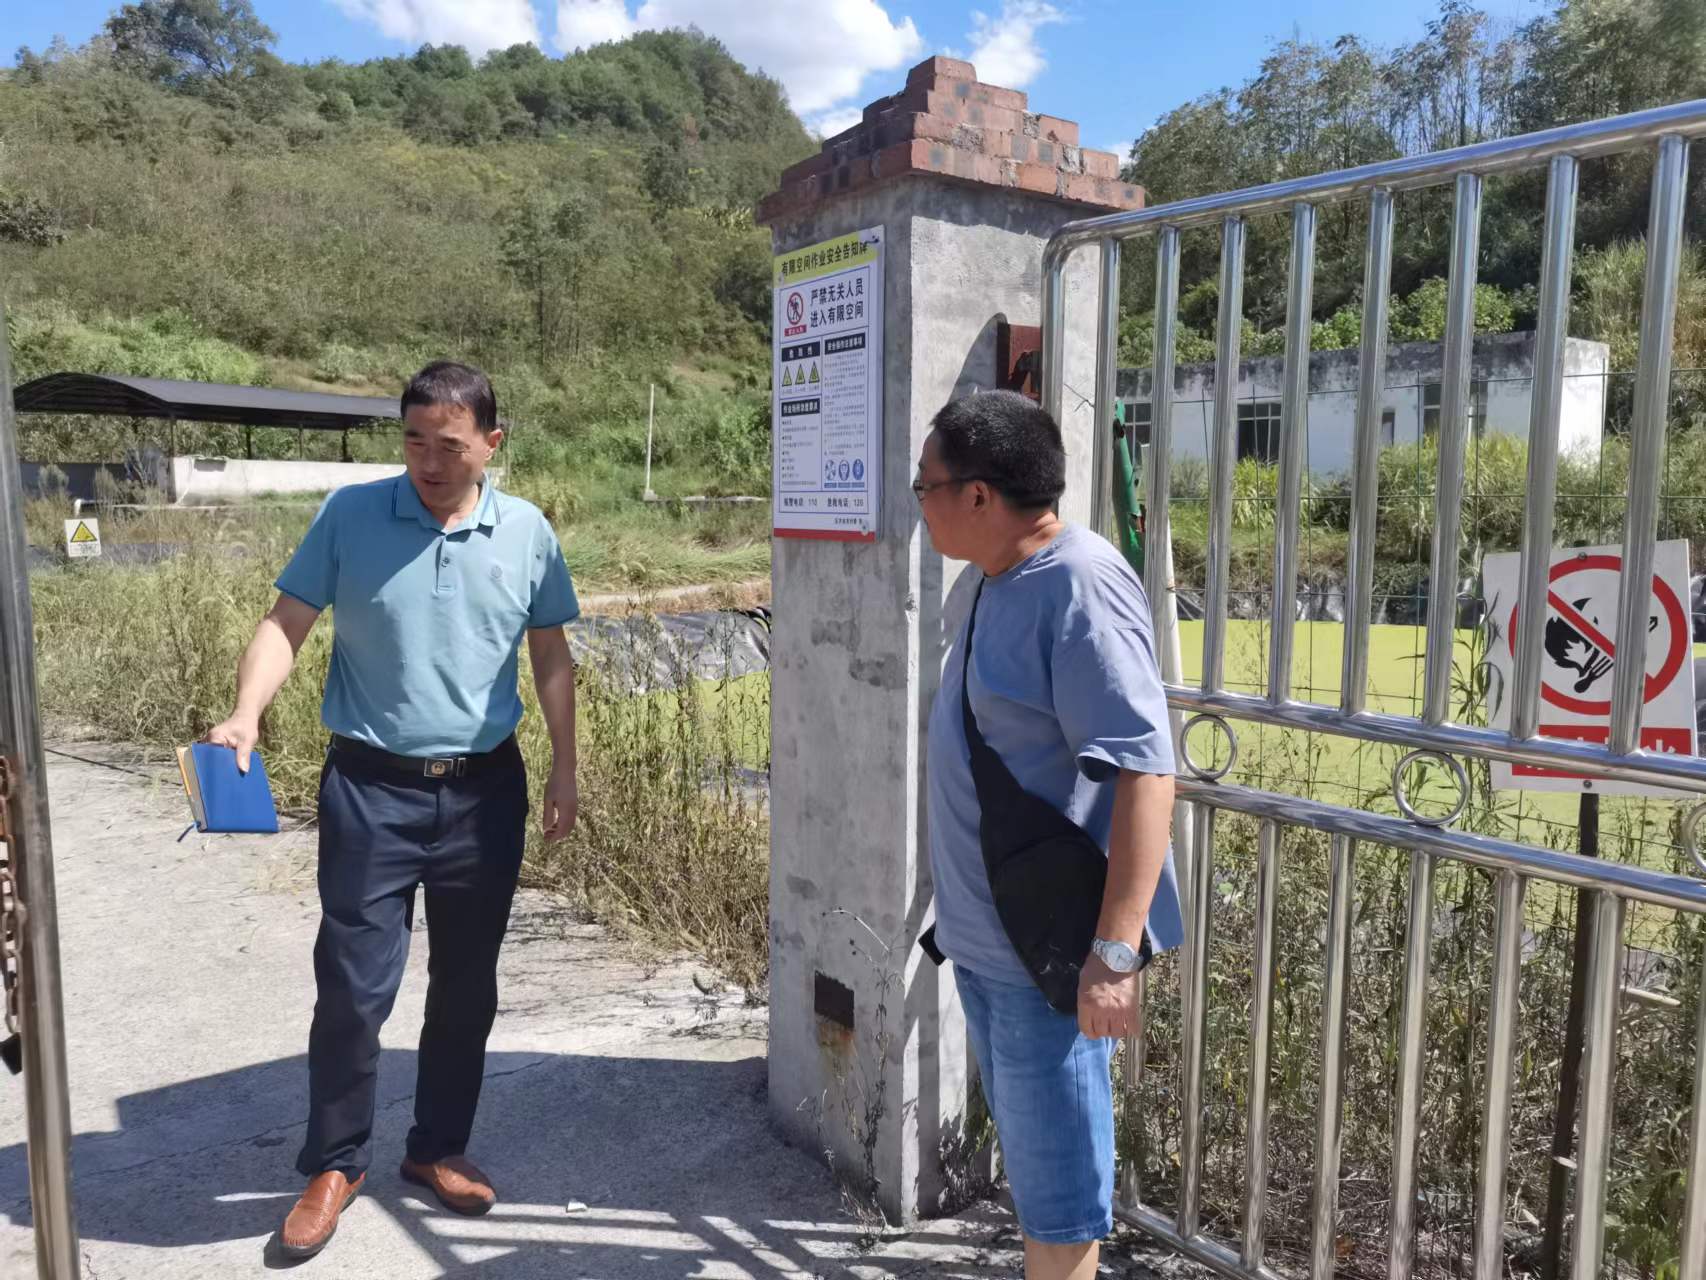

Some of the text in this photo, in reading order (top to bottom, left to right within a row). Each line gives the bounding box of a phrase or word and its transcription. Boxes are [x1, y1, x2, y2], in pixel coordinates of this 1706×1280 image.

[811, 278, 864, 307] 严禁无关人员
[810, 301, 864, 328] 进入有限空间
